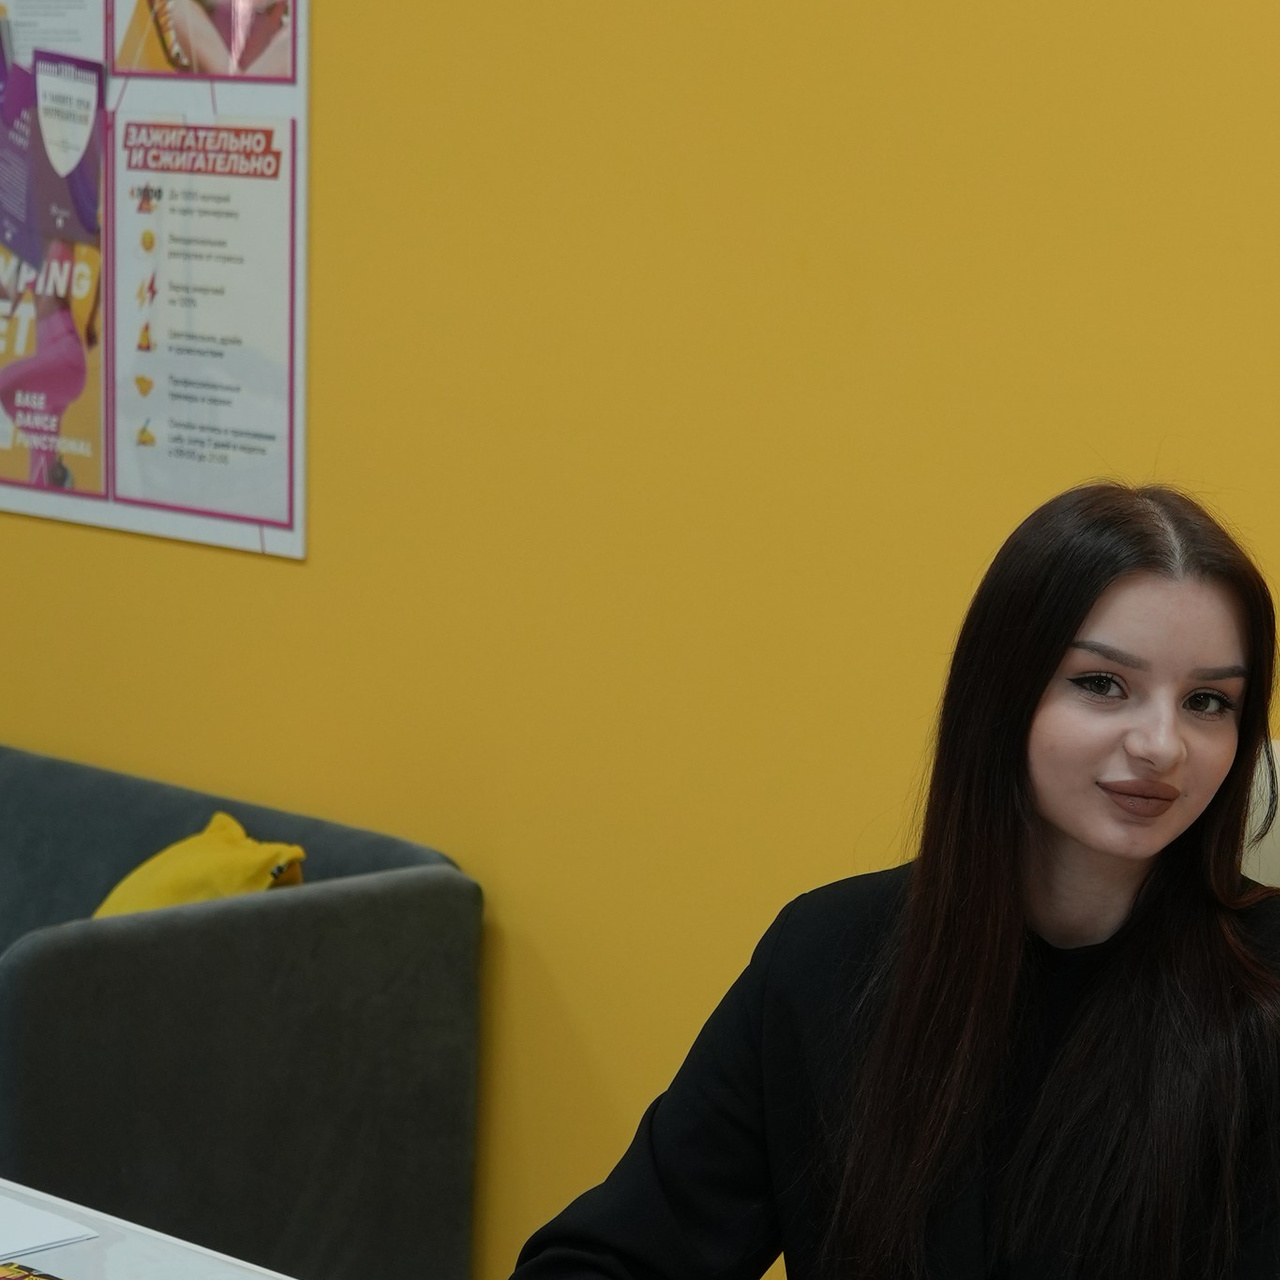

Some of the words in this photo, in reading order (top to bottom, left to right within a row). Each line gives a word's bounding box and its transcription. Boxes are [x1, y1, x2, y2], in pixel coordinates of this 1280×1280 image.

[126, 125, 267, 153] ЗАЖИГАТЕЛЬНО
[130, 149, 145, 167] И
[147, 150, 277, 177] СЖИГАТЕЛЬНО
